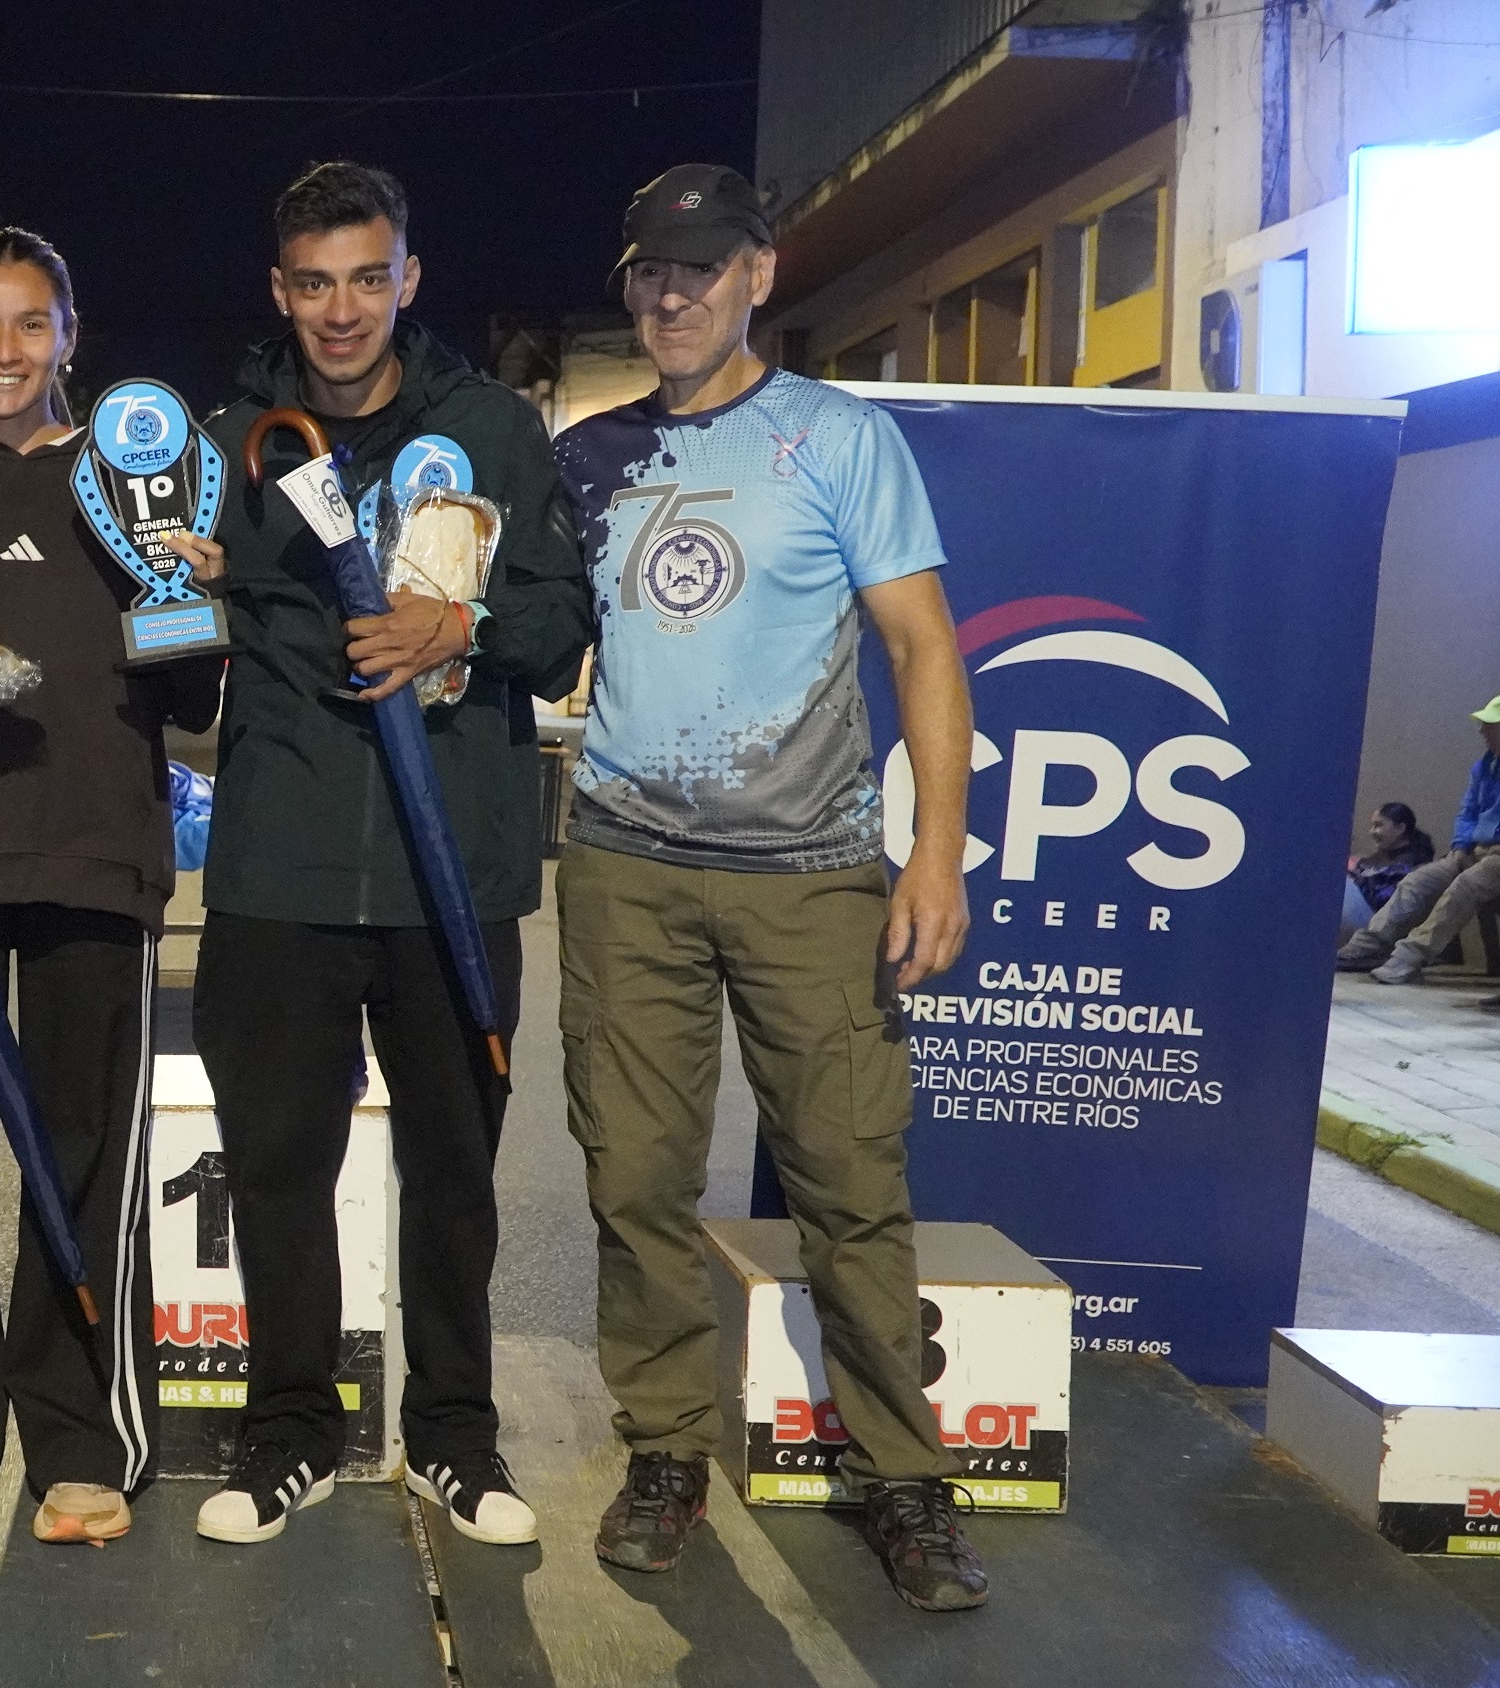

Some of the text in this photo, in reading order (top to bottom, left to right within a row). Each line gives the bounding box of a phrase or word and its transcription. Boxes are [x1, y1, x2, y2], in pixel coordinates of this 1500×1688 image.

[106, 395, 170, 445] 75
[122, 449, 170, 463] CPCEER
[408, 440, 458, 490] 75
[302, 472, 320, 497] Omar
[318, 494, 343, 537] Gutierrez
[133, 517, 183, 532] GENERAL
[152, 558, 176, 570] 2026
[610, 482, 746, 619] 75
[992, 898, 1171, 931] CEER
[979, 961, 1123, 995] CAJA DE
[1081, 1003, 1203, 1036] SOCIAL
[909, 1036, 1200, 1074] ARA PROFESIONALES
[1035, 1071, 1223, 1105] ECONÓMICAS
[932, 1095, 1140, 1130] DE ENTRE RÍOS
[1072, 1294, 1139, 1318] rg.ar
[1090, 1338, 1101, 1351] 4
[1106, 1338, 1133, 1353] 551
[1137, 1340, 1172, 1355] 605
[198, 1358, 227, 1373] de
[198, 1386, 215, 1402] &
[776, 1399, 1038, 1447] BOLOT
[968, 1456, 1029, 1472] rtes
